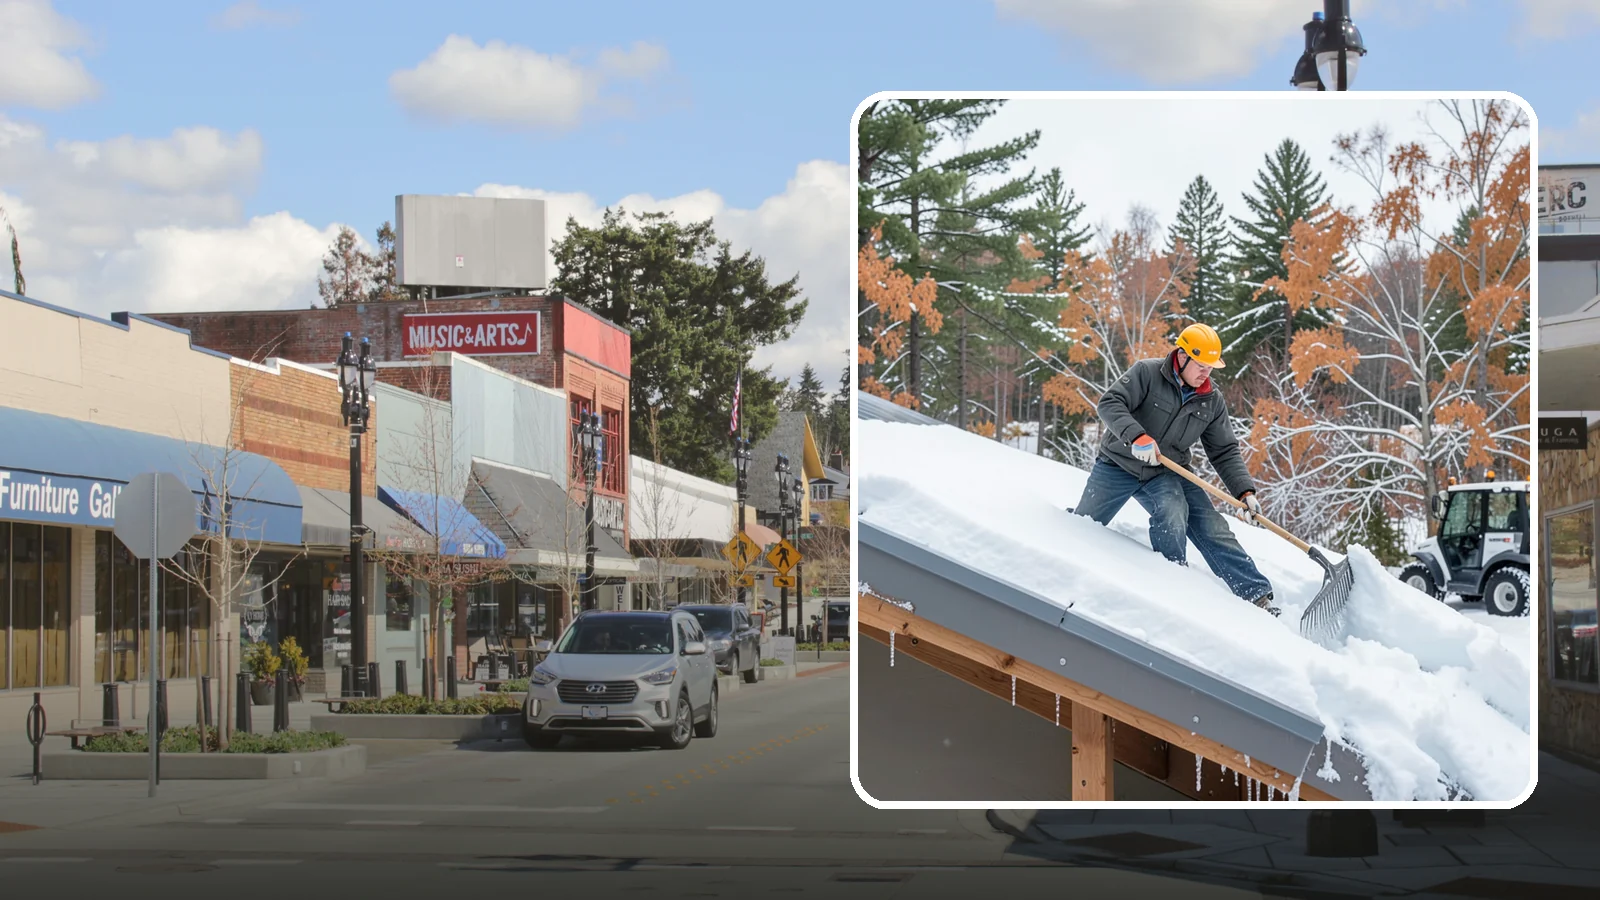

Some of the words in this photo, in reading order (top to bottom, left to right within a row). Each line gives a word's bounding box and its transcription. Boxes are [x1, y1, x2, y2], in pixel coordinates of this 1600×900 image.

[409, 323, 519, 349] MUSIC&ARTS
[0, 472, 80, 515] Furniture
[89, 482, 122, 519] Gal
